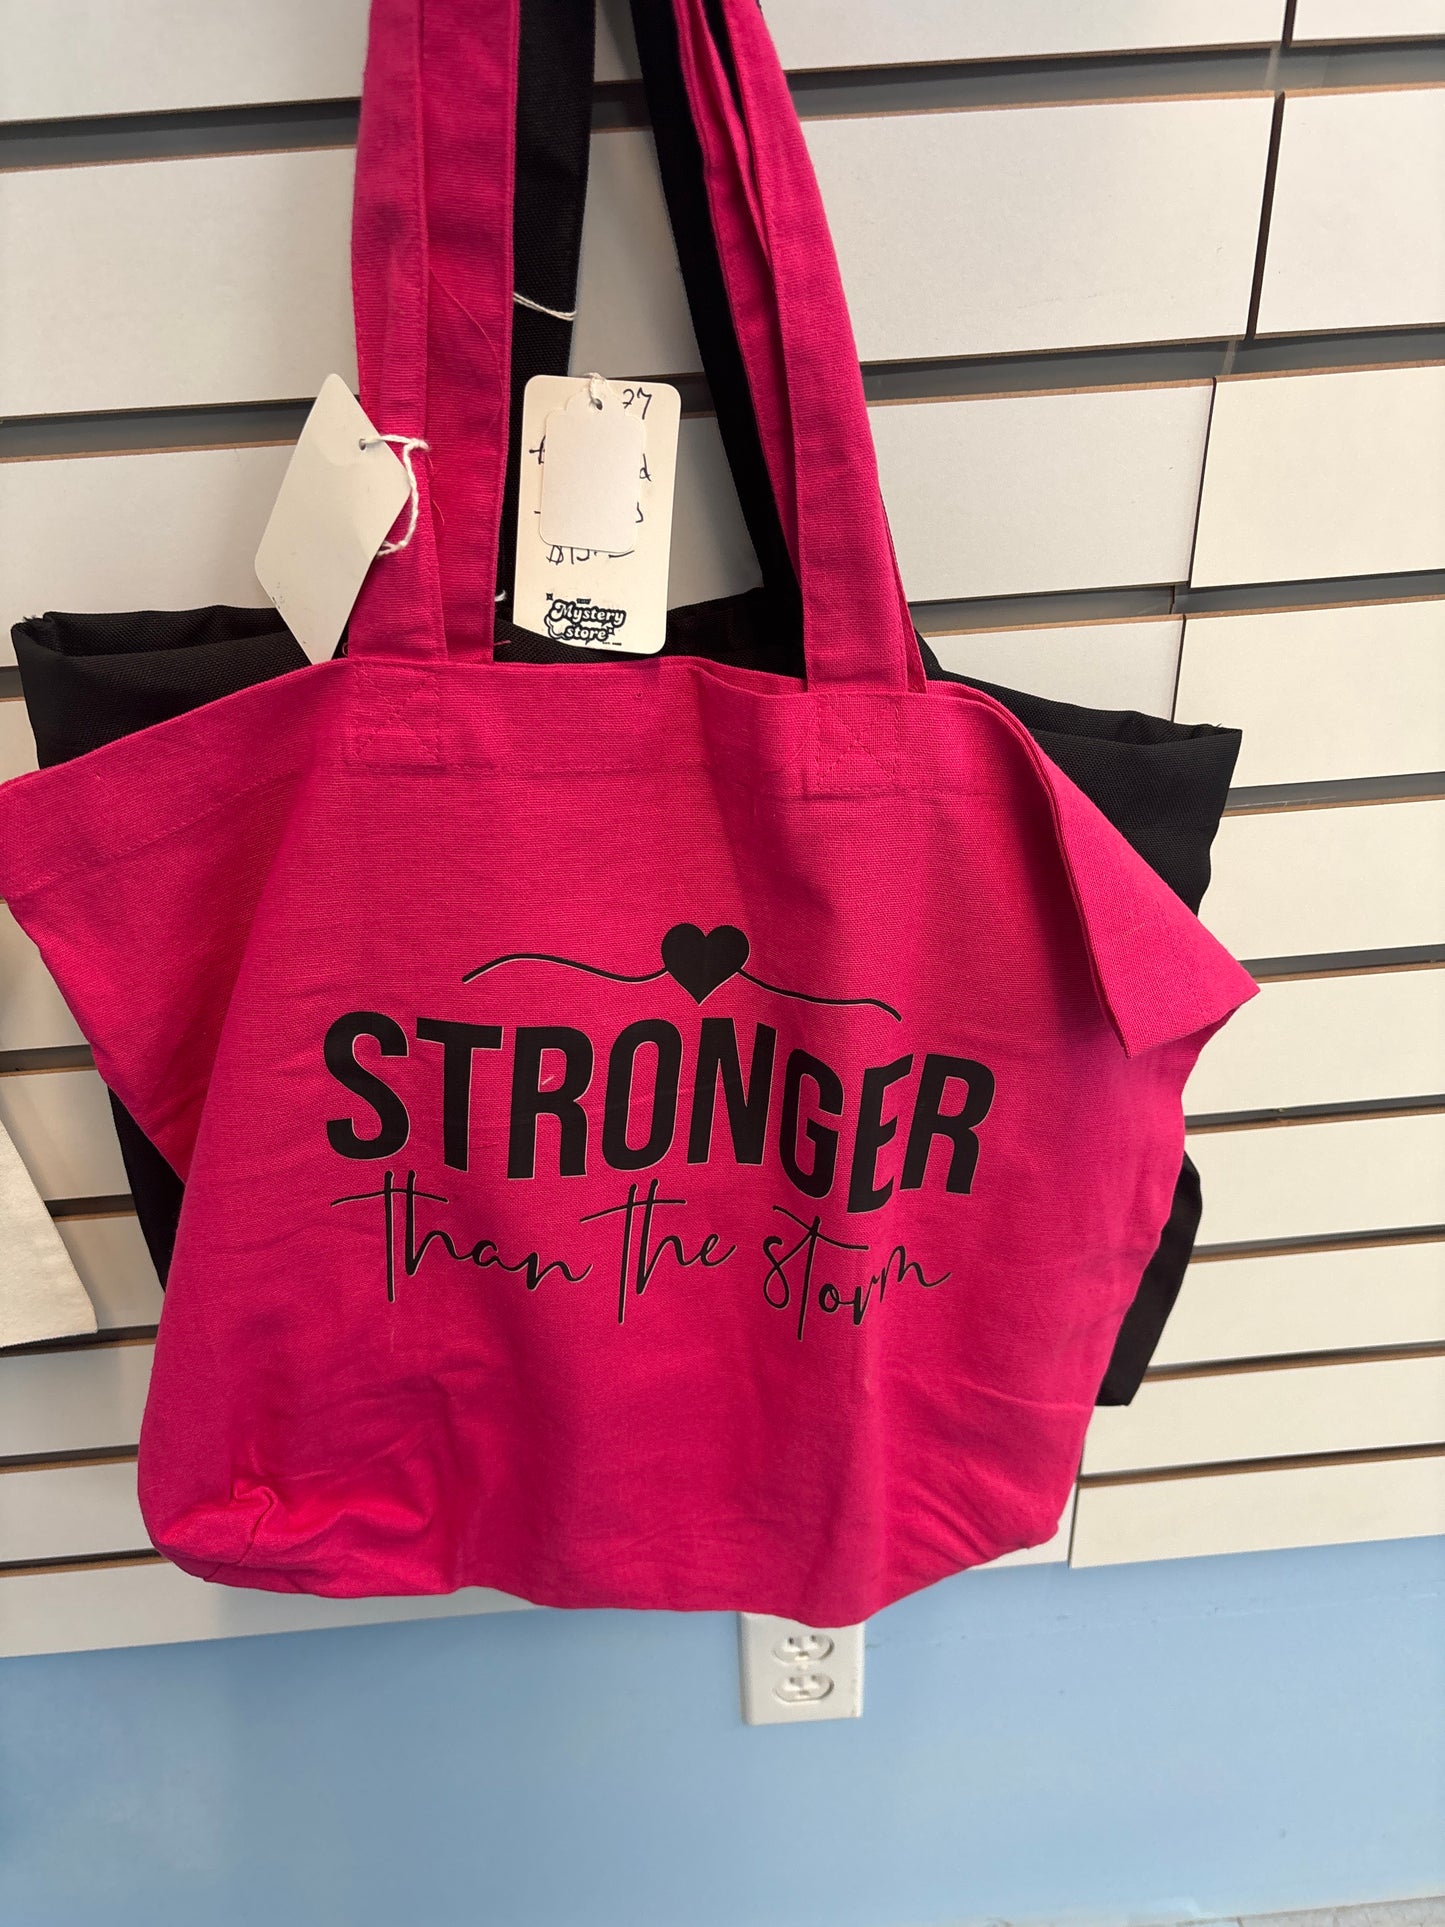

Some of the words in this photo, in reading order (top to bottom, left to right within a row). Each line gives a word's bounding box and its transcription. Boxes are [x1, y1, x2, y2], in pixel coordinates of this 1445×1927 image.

[549, 600, 626, 628] Mystery
[564, 624, 609, 642] store
[323, 1010, 995, 1214] STRONGER
[331, 1169, 592, 1303] than
[580, 1178, 736, 1324] the
[762, 1205, 952, 1341] storm
